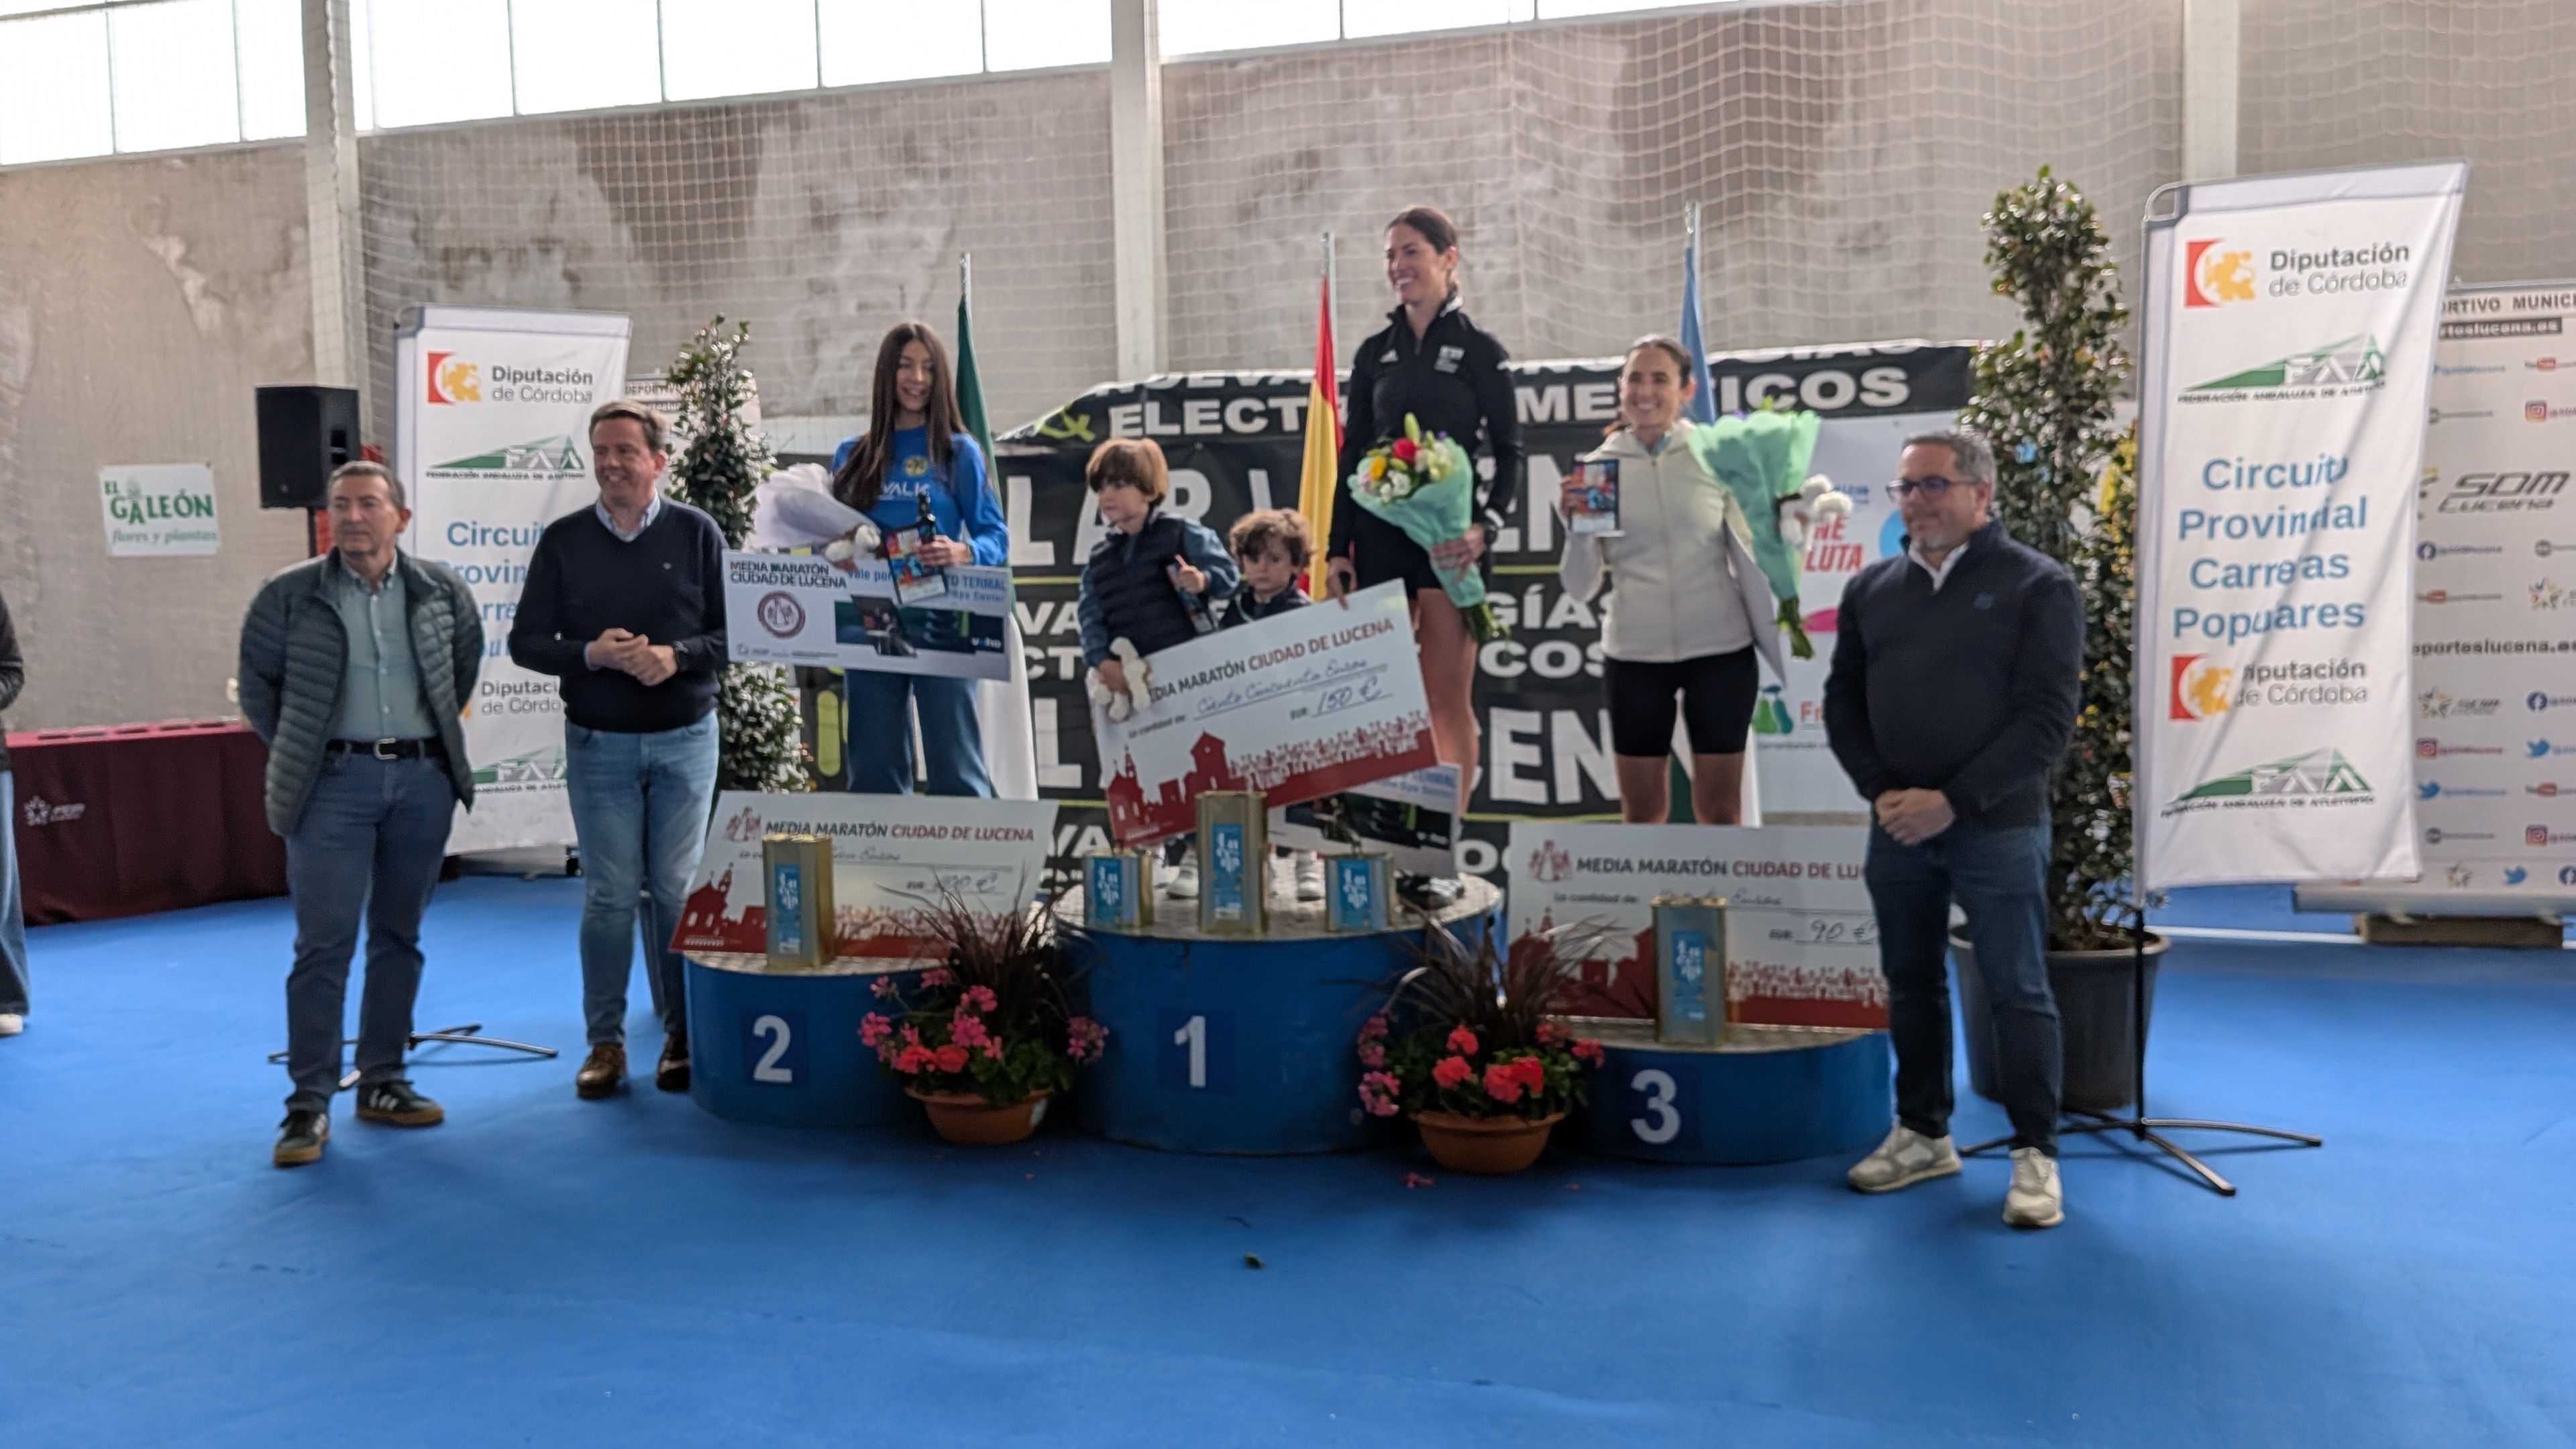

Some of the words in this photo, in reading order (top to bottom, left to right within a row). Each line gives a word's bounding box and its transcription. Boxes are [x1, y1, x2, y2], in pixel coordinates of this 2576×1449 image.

[2270, 242, 2410, 274] Diputación
[2269, 276, 2300, 297] de
[2308, 268, 2407, 295] Córdoba
[492, 365, 593, 386] Diputación
[492, 386, 515, 401] de
[521, 384, 593, 402] Córdoba
[104, 480, 119, 495] EL
[110, 488, 214, 525] GALEÓN
[730, 560, 768, 572] MEDIA
[771, 560, 830, 575] MARATÓN
[730, 572, 779, 586] CIUDAD
[780, 574, 794, 586] DE
[798, 574, 847, 588] LUCENA
[1179, 659, 1246, 692] MARATÓN
[1248, 642, 1305, 671] CIUDAD
[1308, 635, 1330, 654] DE
[1332, 617, 1395, 647] LUCENA
[2267, 683, 2368, 706] Córdoba
[481, 700, 503, 716] de
[815, 820, 888, 837] MARATÓN
[890, 824, 949, 839] CIUDAD
[951, 825, 971, 839] DE
[975, 826, 1034, 842] LUCENA
[1577, 857, 1633, 874] MEDIA
[1638, 856, 1727, 876] MARATÓN
[1732, 860, 1803, 879] CIUDAD
[1807, 862, 1831, 879] DE
[1811, 918, 1844, 941] 90
[752, 1014, 793, 1083] 2
[1173, 1015, 1207, 1087] 1
[1629, 1068, 1682, 1145] 3
